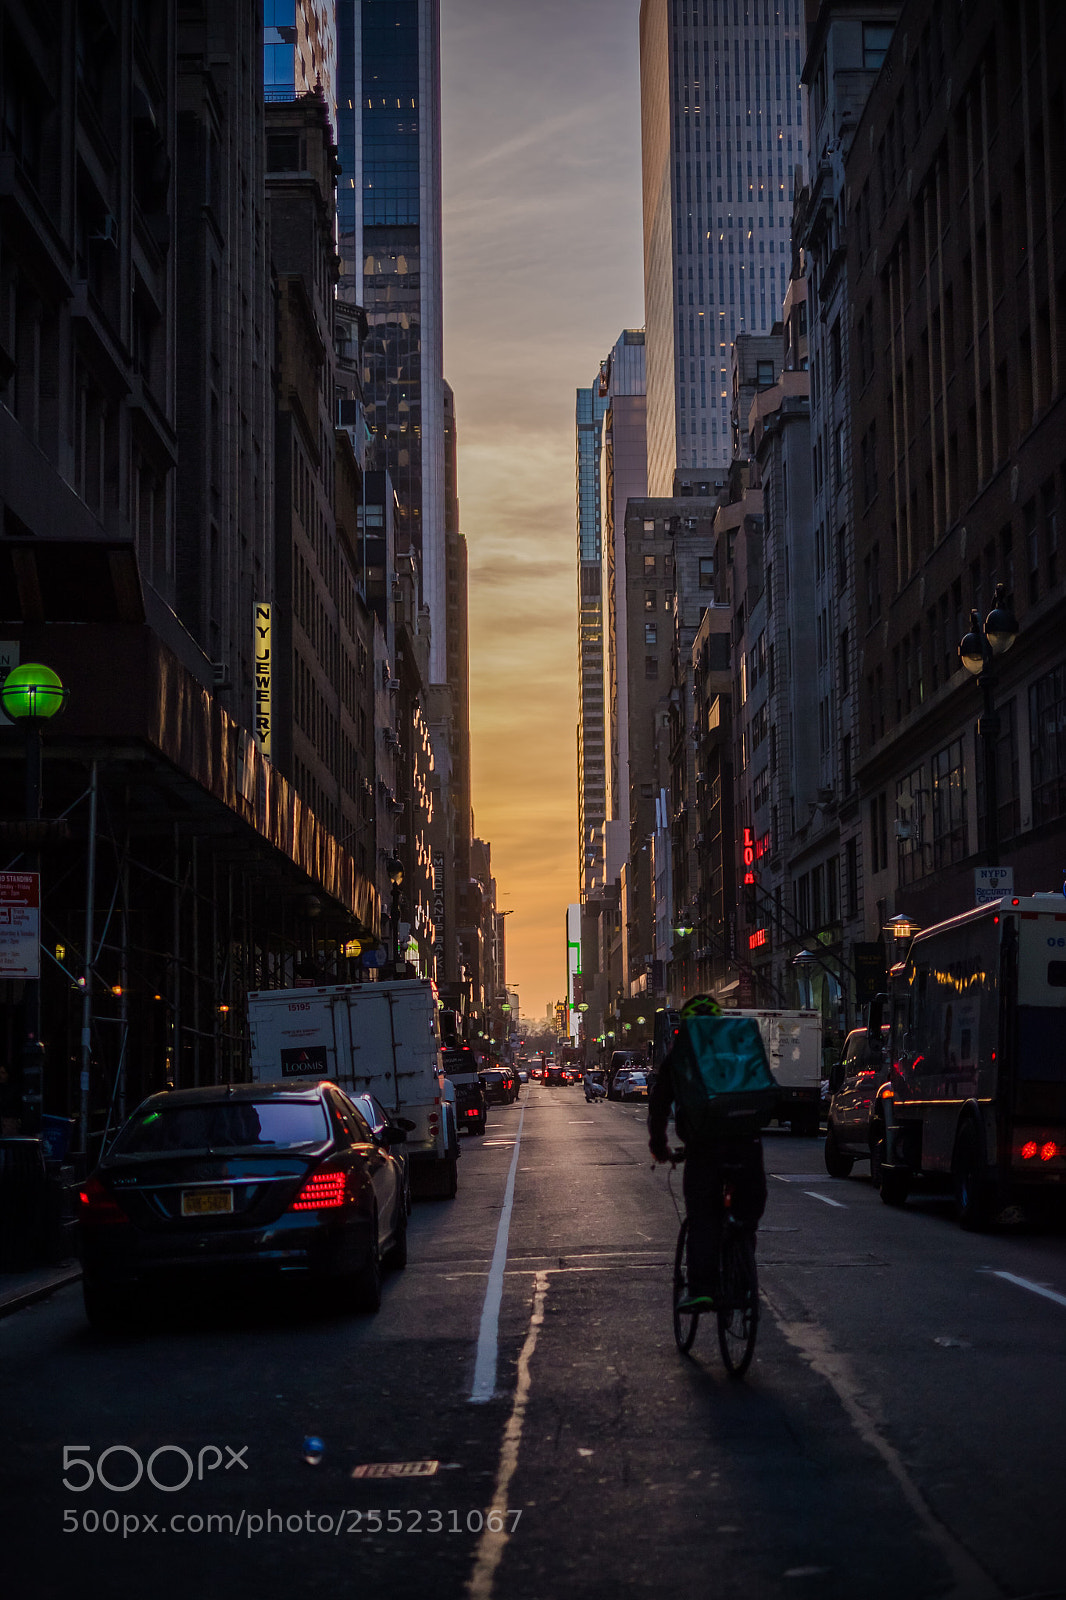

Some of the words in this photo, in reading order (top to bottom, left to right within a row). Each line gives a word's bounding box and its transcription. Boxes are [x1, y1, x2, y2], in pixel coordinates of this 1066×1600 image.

[256, 649, 270, 743] JEWELRY
[980, 869, 1007, 878] NYPD
[6, 875, 33, 883] STANDING
[976, 887, 1013, 896] SECURITY
[288, 1002, 311, 1012] 15195
[285, 1060, 324, 1073] LOOMIS
